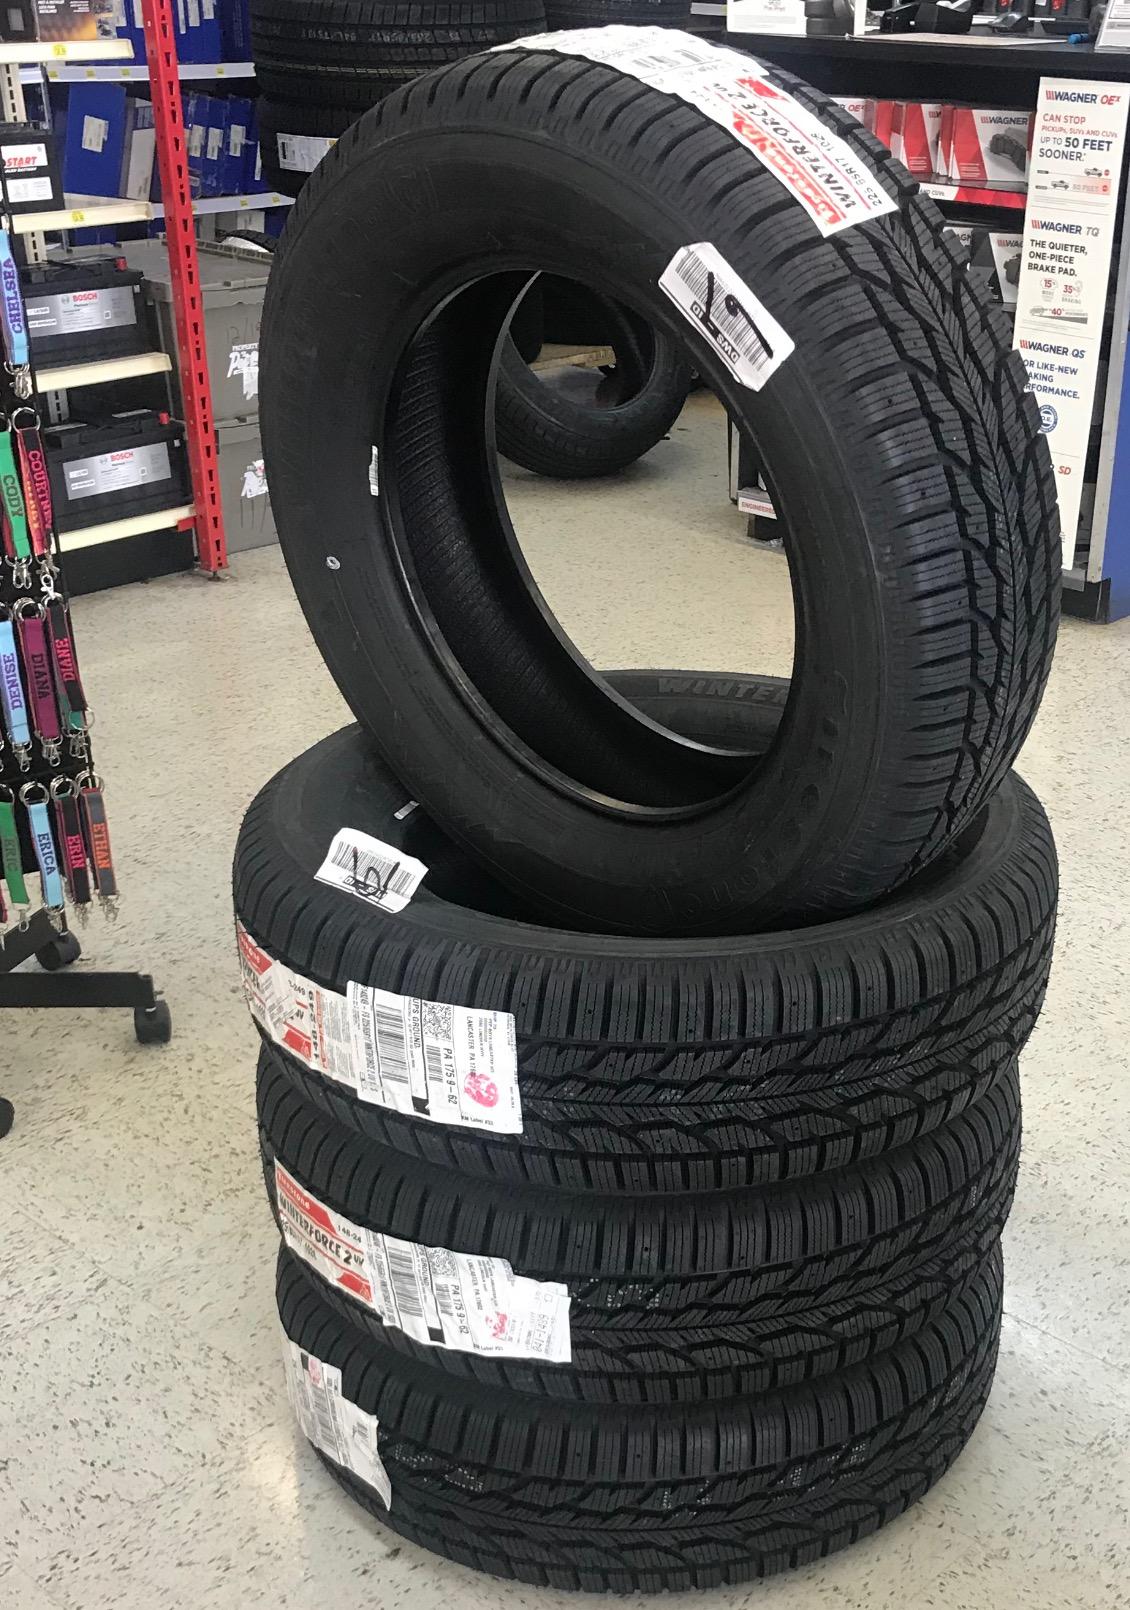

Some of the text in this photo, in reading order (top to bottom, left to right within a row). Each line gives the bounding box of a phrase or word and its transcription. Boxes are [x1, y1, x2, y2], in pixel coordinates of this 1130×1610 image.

[1054, 91, 1097, 104] WAGNER
[989, 117, 1028, 126] WAGNER
[1043, 113, 1086, 125] CAN STOP
[1086, 129, 1100, 137] AND
[1040, 136, 1112, 152] UP TO 50 FEET
[1039, 221, 1100, 237] WAGNER TQ
[1030, 239, 1088, 255] THE QUIETER,
[1029, 251, 1075, 264] ONE-PIECE
[1028, 262, 1077, 277] BRAKE PAD.
[3, 258, 23, 334] CHELSEA
[73, 292, 97, 302] BOSCH
[716, 333, 741, 363] DWS
[1028, 341, 1086, 359] WAGNER QS
[1037, 363, 1078, 375] LIKE-NEW
[111, 451, 133, 461] BOSCH
[1058, 466, 1071, 475] SD
[3, 474, 23, 518] CODY
[28, 450, 53, 530] COURTNEY
[55, 638, 75, 681] DIANE
[3, 653, 23, 710] DENISE
[32, 653, 50, 699] DIANA
[67, 834, 86, 869] ERIN
[93, 823, 110, 869] ETHAN
[37, 833, 57, 876] ERICA
[413, 1016, 421, 1049] GROUND
[467, 1016, 475, 1051] LANCASTER
[443, 1048, 453, 1059] PA
[469, 1053, 476, 1061] PA
[445, 1062, 455, 1078] 175
[279, 1193, 342, 1259] WINTERFORCE
[343, 1251, 352, 1265] 2
[466, 1259, 478, 1286] LANCASTER
[451, 1284, 460, 1295] PA
